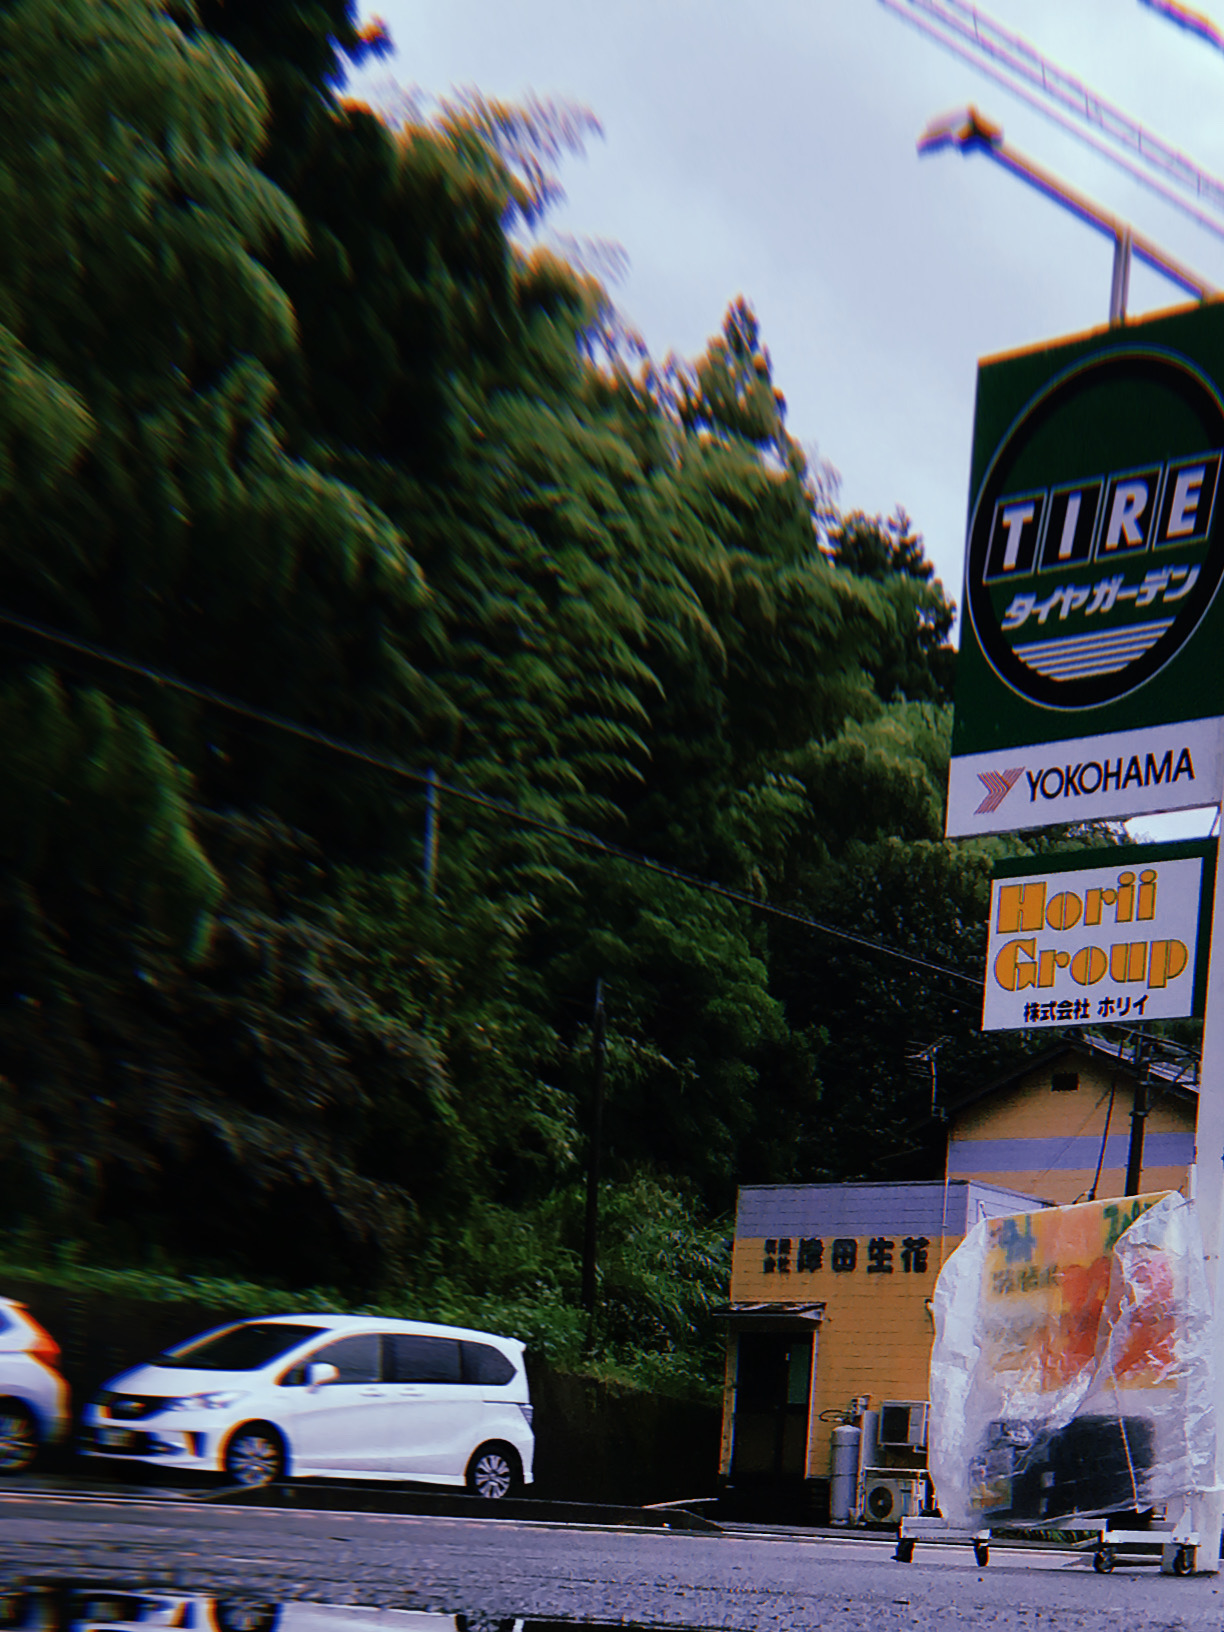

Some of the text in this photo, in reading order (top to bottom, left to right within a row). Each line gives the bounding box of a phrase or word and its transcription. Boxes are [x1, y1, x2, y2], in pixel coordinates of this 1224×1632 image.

[1001, 463, 1206, 572] TIRE
[1000, 564, 1200, 631] タイヤガーデン
[1026, 748, 1195, 802] YOKOHAMA
[996, 869, 1157, 934] Horii
[994, 938, 1188, 991] Group
[1023, 994, 1149, 1022] 株式会社 ホリイ
